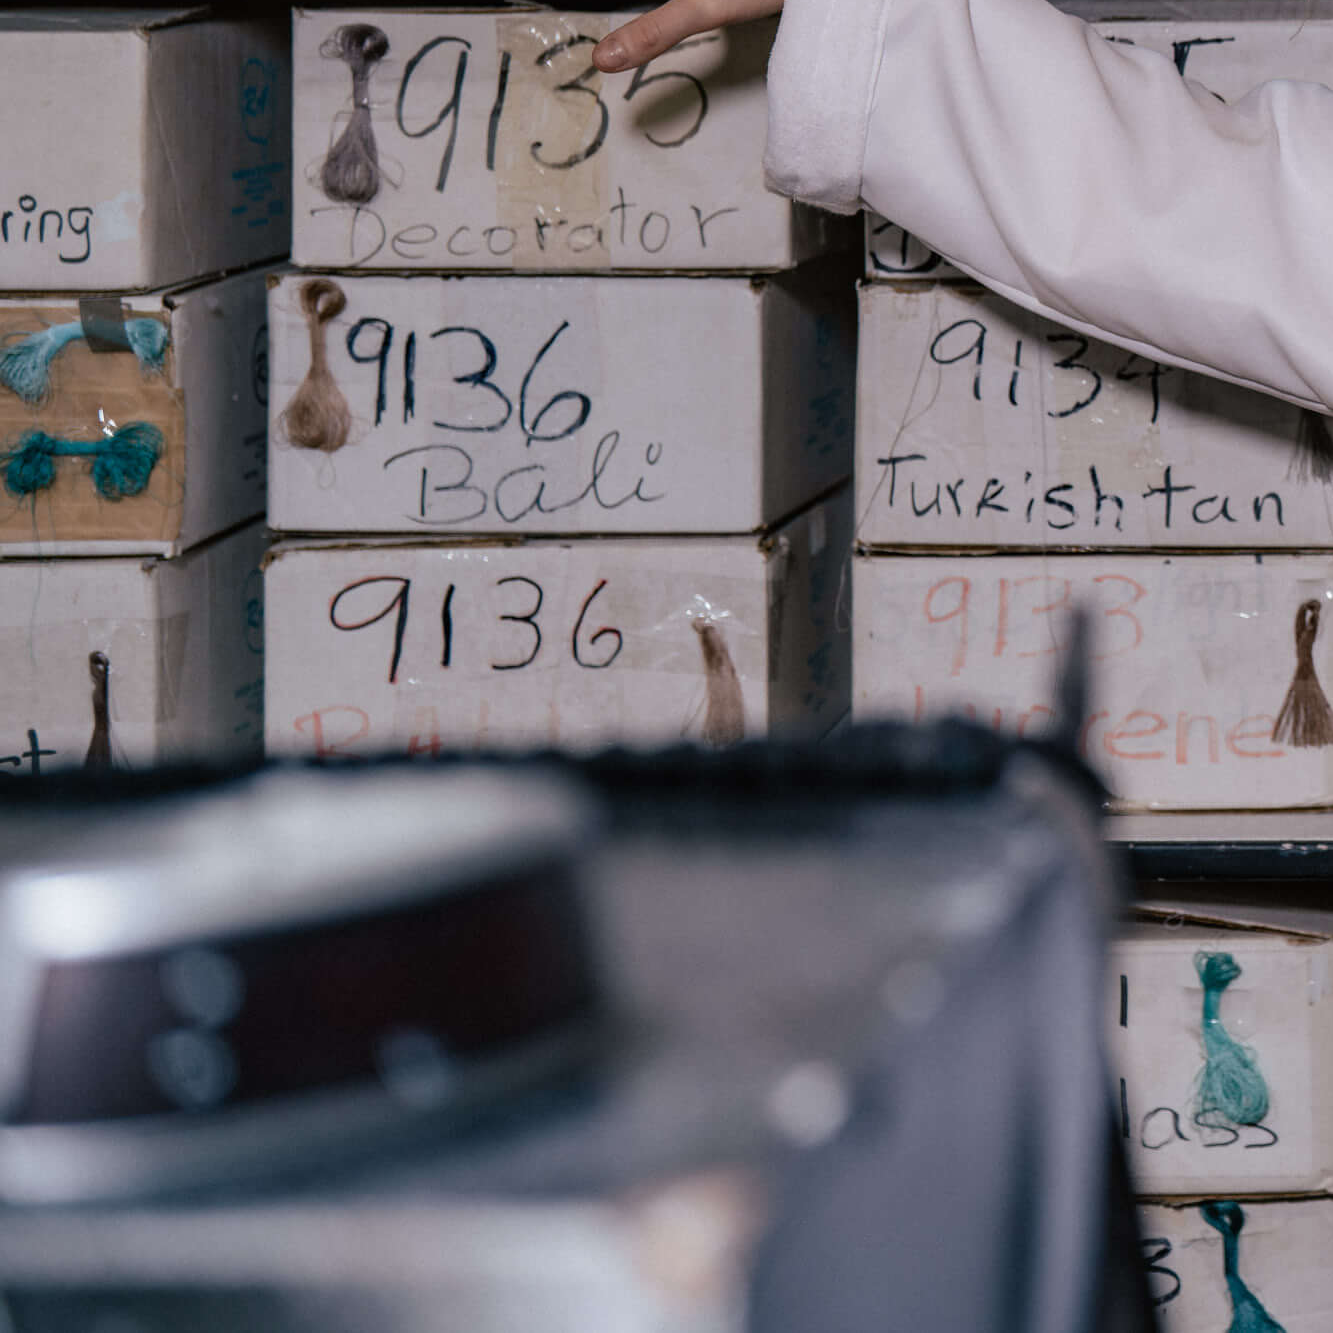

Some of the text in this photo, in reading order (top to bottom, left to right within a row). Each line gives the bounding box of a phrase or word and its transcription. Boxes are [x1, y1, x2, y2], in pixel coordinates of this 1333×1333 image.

[396, 35, 719, 193] 9135
[310, 186, 739, 268] Decorator
[346, 317, 592, 448] 9136
[383, 430, 667, 525] Bali
[328, 575, 623, 685] 9136
